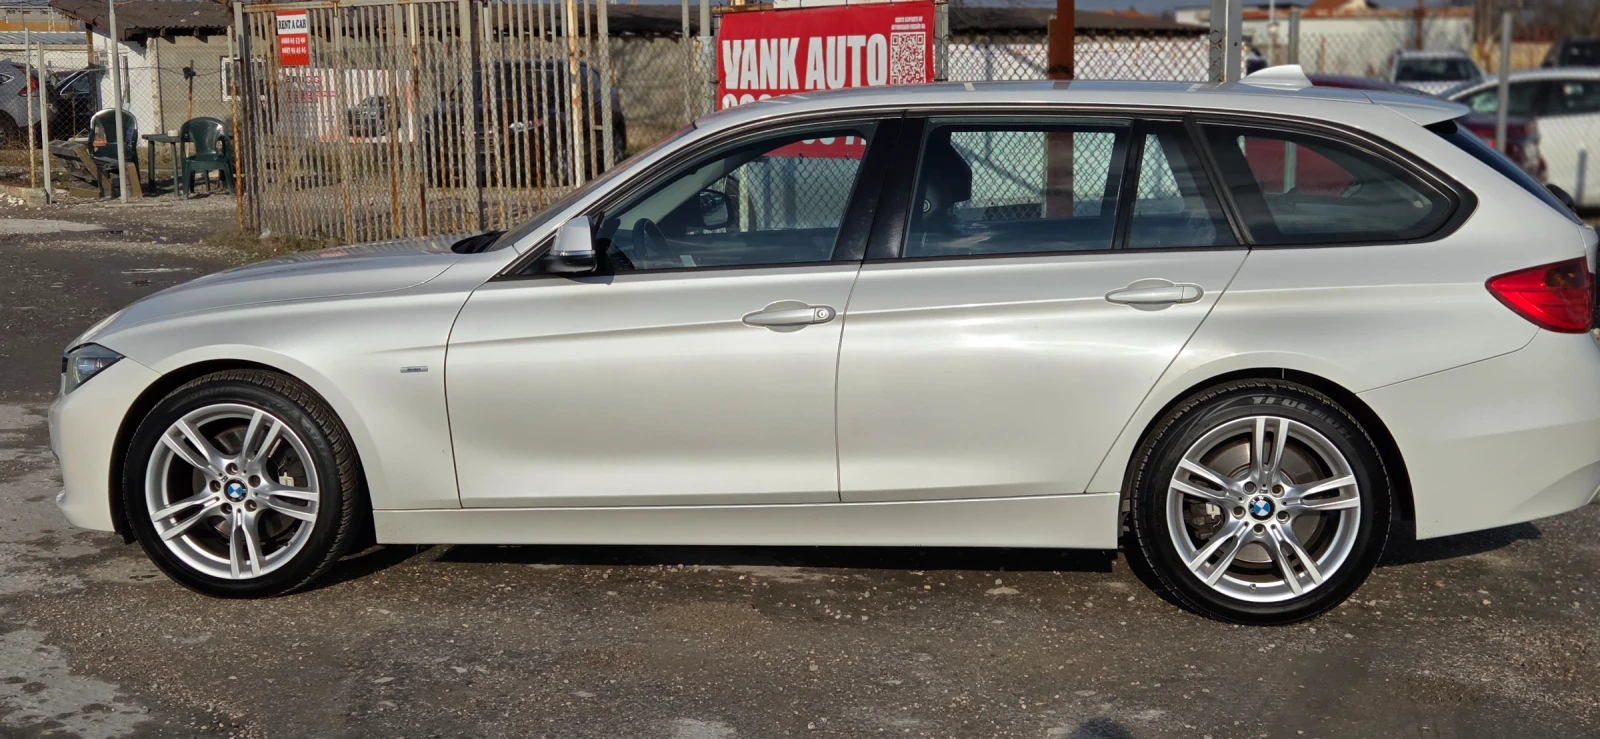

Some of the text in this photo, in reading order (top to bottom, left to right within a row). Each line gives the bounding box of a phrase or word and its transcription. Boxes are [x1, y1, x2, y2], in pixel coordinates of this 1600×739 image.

[278, 19, 306, 29] RENT A CAR
[722, 33, 888, 90] VANK AUTO
